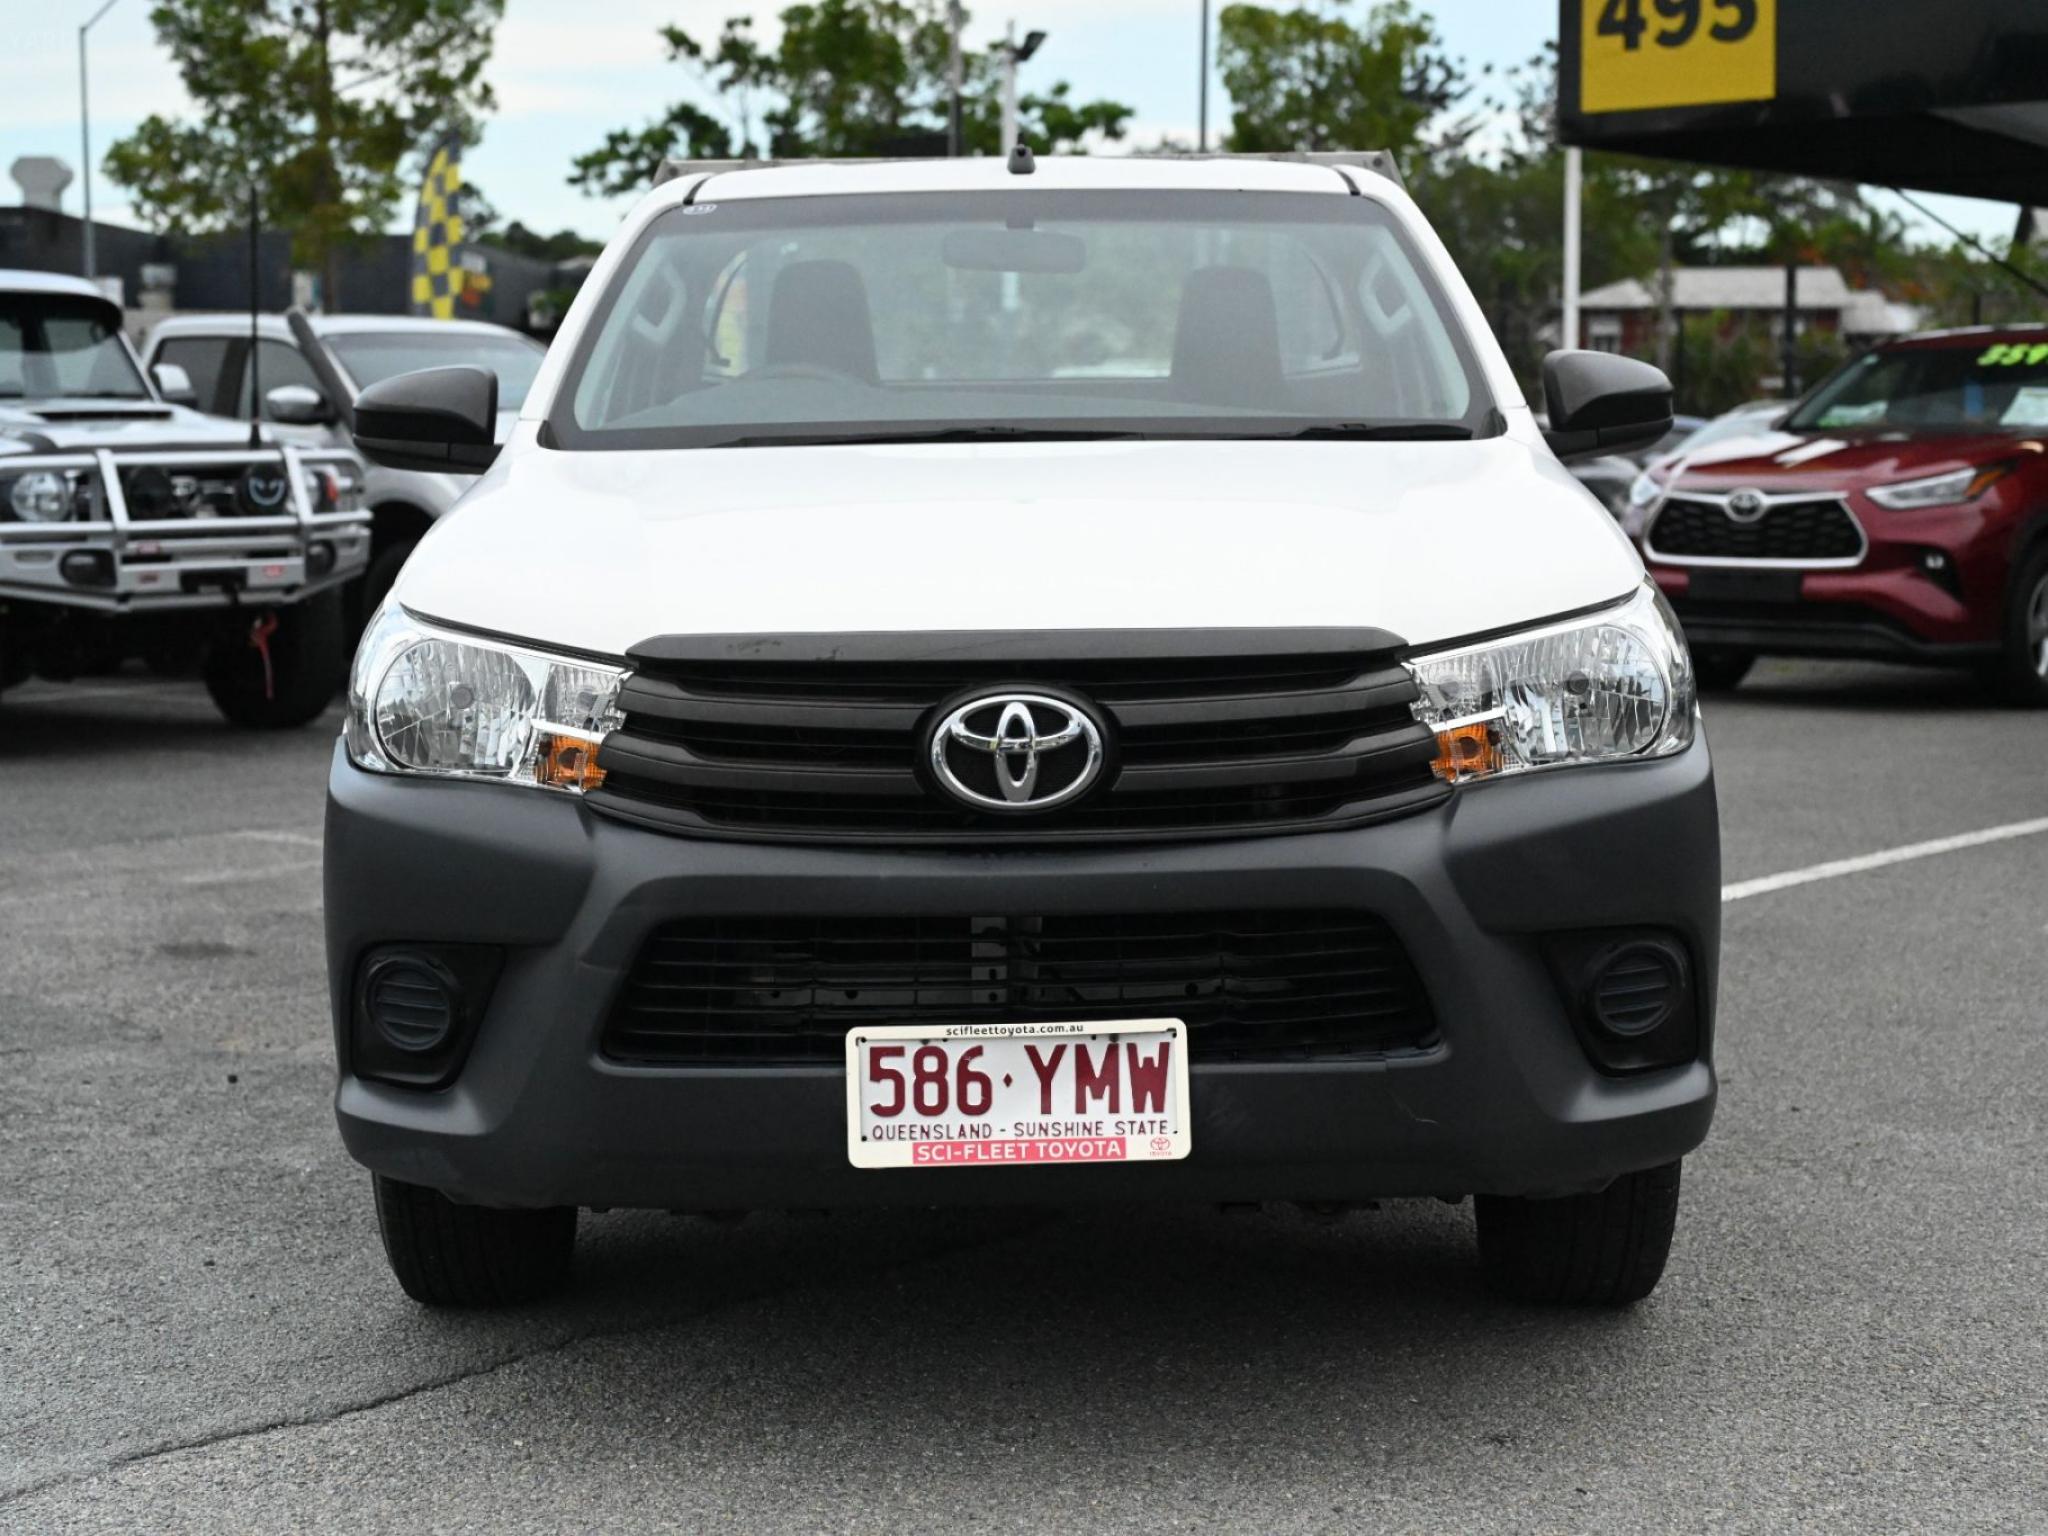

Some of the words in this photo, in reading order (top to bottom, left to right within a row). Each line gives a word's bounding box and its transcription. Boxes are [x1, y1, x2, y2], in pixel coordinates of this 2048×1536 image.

[946, 1024, 1084, 1037] scifleettoyota.com.au
[872, 1123, 992, 1140] QUEENSLAND
[1014, 1121, 1104, 1137] SUNSHINE
[1115, 1120, 1168, 1135] STATE
[917, 1144, 1029, 1161] SCI-FLEET
[1035, 1140, 1122, 1158] TOYOTA
